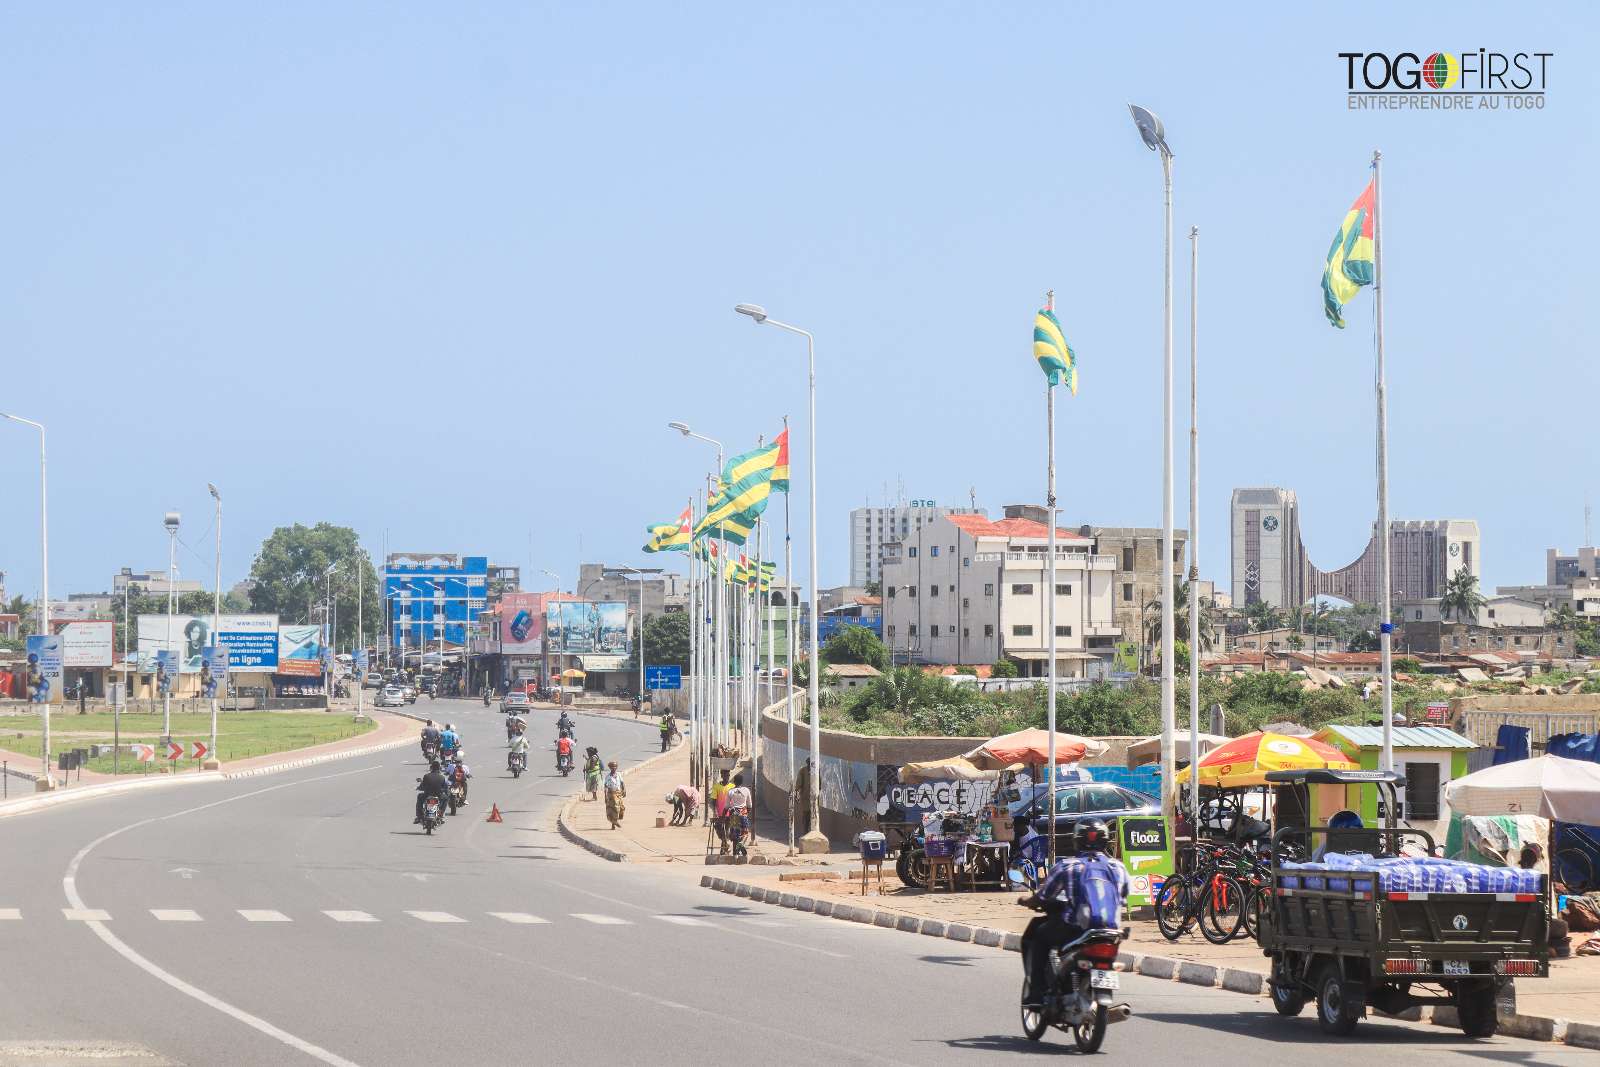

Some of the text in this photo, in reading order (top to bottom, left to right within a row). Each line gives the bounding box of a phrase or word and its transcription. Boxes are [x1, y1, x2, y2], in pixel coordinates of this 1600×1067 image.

[241, 655, 262, 665] ligne
[893, 788, 967, 805] PEACE
[1130, 831, 1161, 844] flooz
